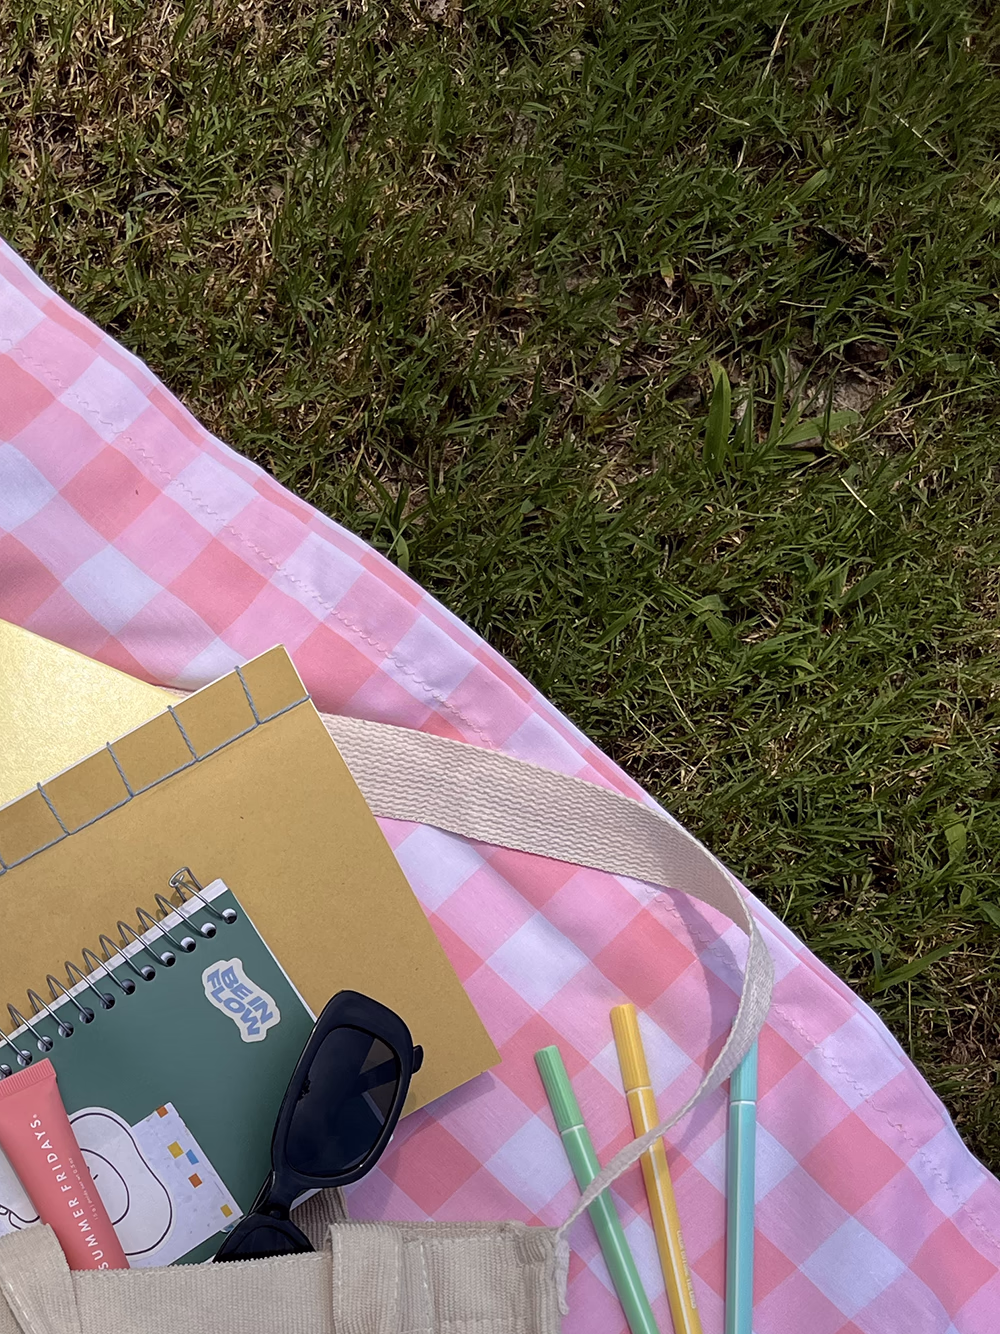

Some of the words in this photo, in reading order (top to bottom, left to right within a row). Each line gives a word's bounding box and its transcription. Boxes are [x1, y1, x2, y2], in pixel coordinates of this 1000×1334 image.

[206, 968, 261, 1036] FLOW
[220, 965, 254, 1001] BE
[246, 996, 274, 1025] IN
[68, 1196, 109, 1270] SUMMER
